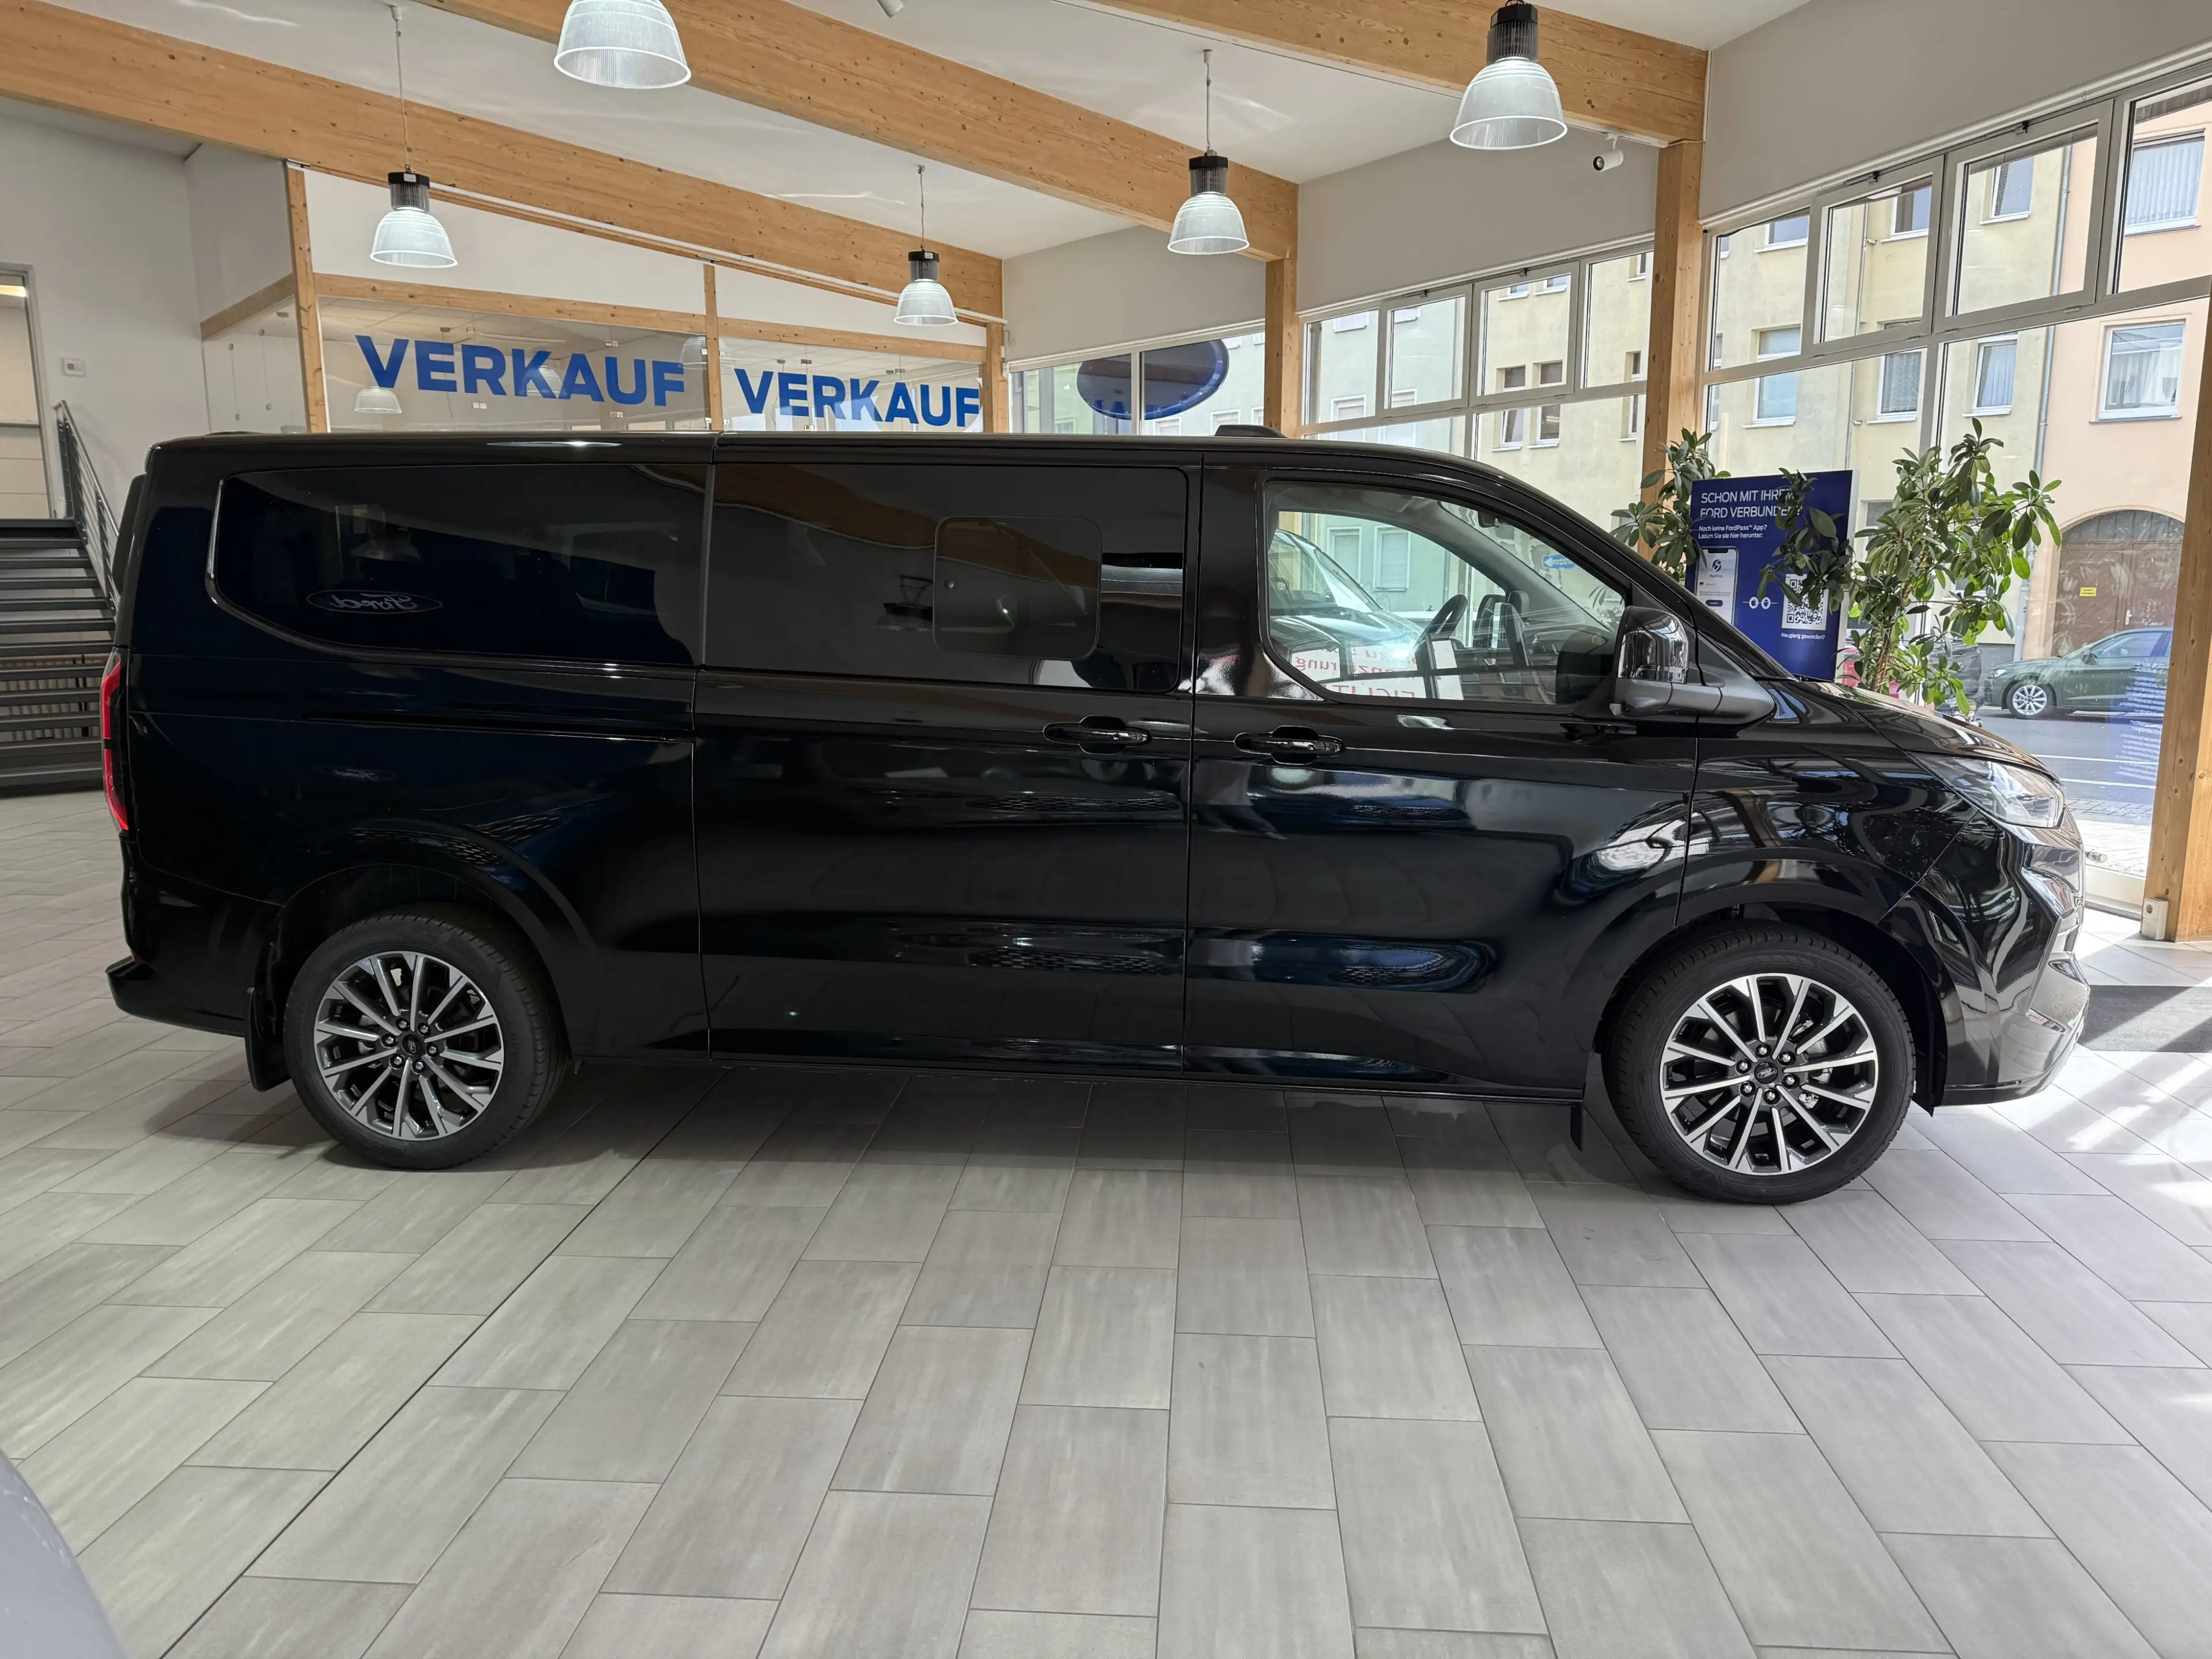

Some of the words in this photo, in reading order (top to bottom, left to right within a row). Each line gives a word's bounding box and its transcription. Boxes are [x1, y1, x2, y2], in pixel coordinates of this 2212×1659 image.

[356, 334, 685, 407] VERKAUF
[734, 368, 980, 427] VERKAUF
[1700, 491, 1738, 503] SCHON
[1740, 490, 1759, 502] MIT
[1700, 507, 1728, 518] FORD
